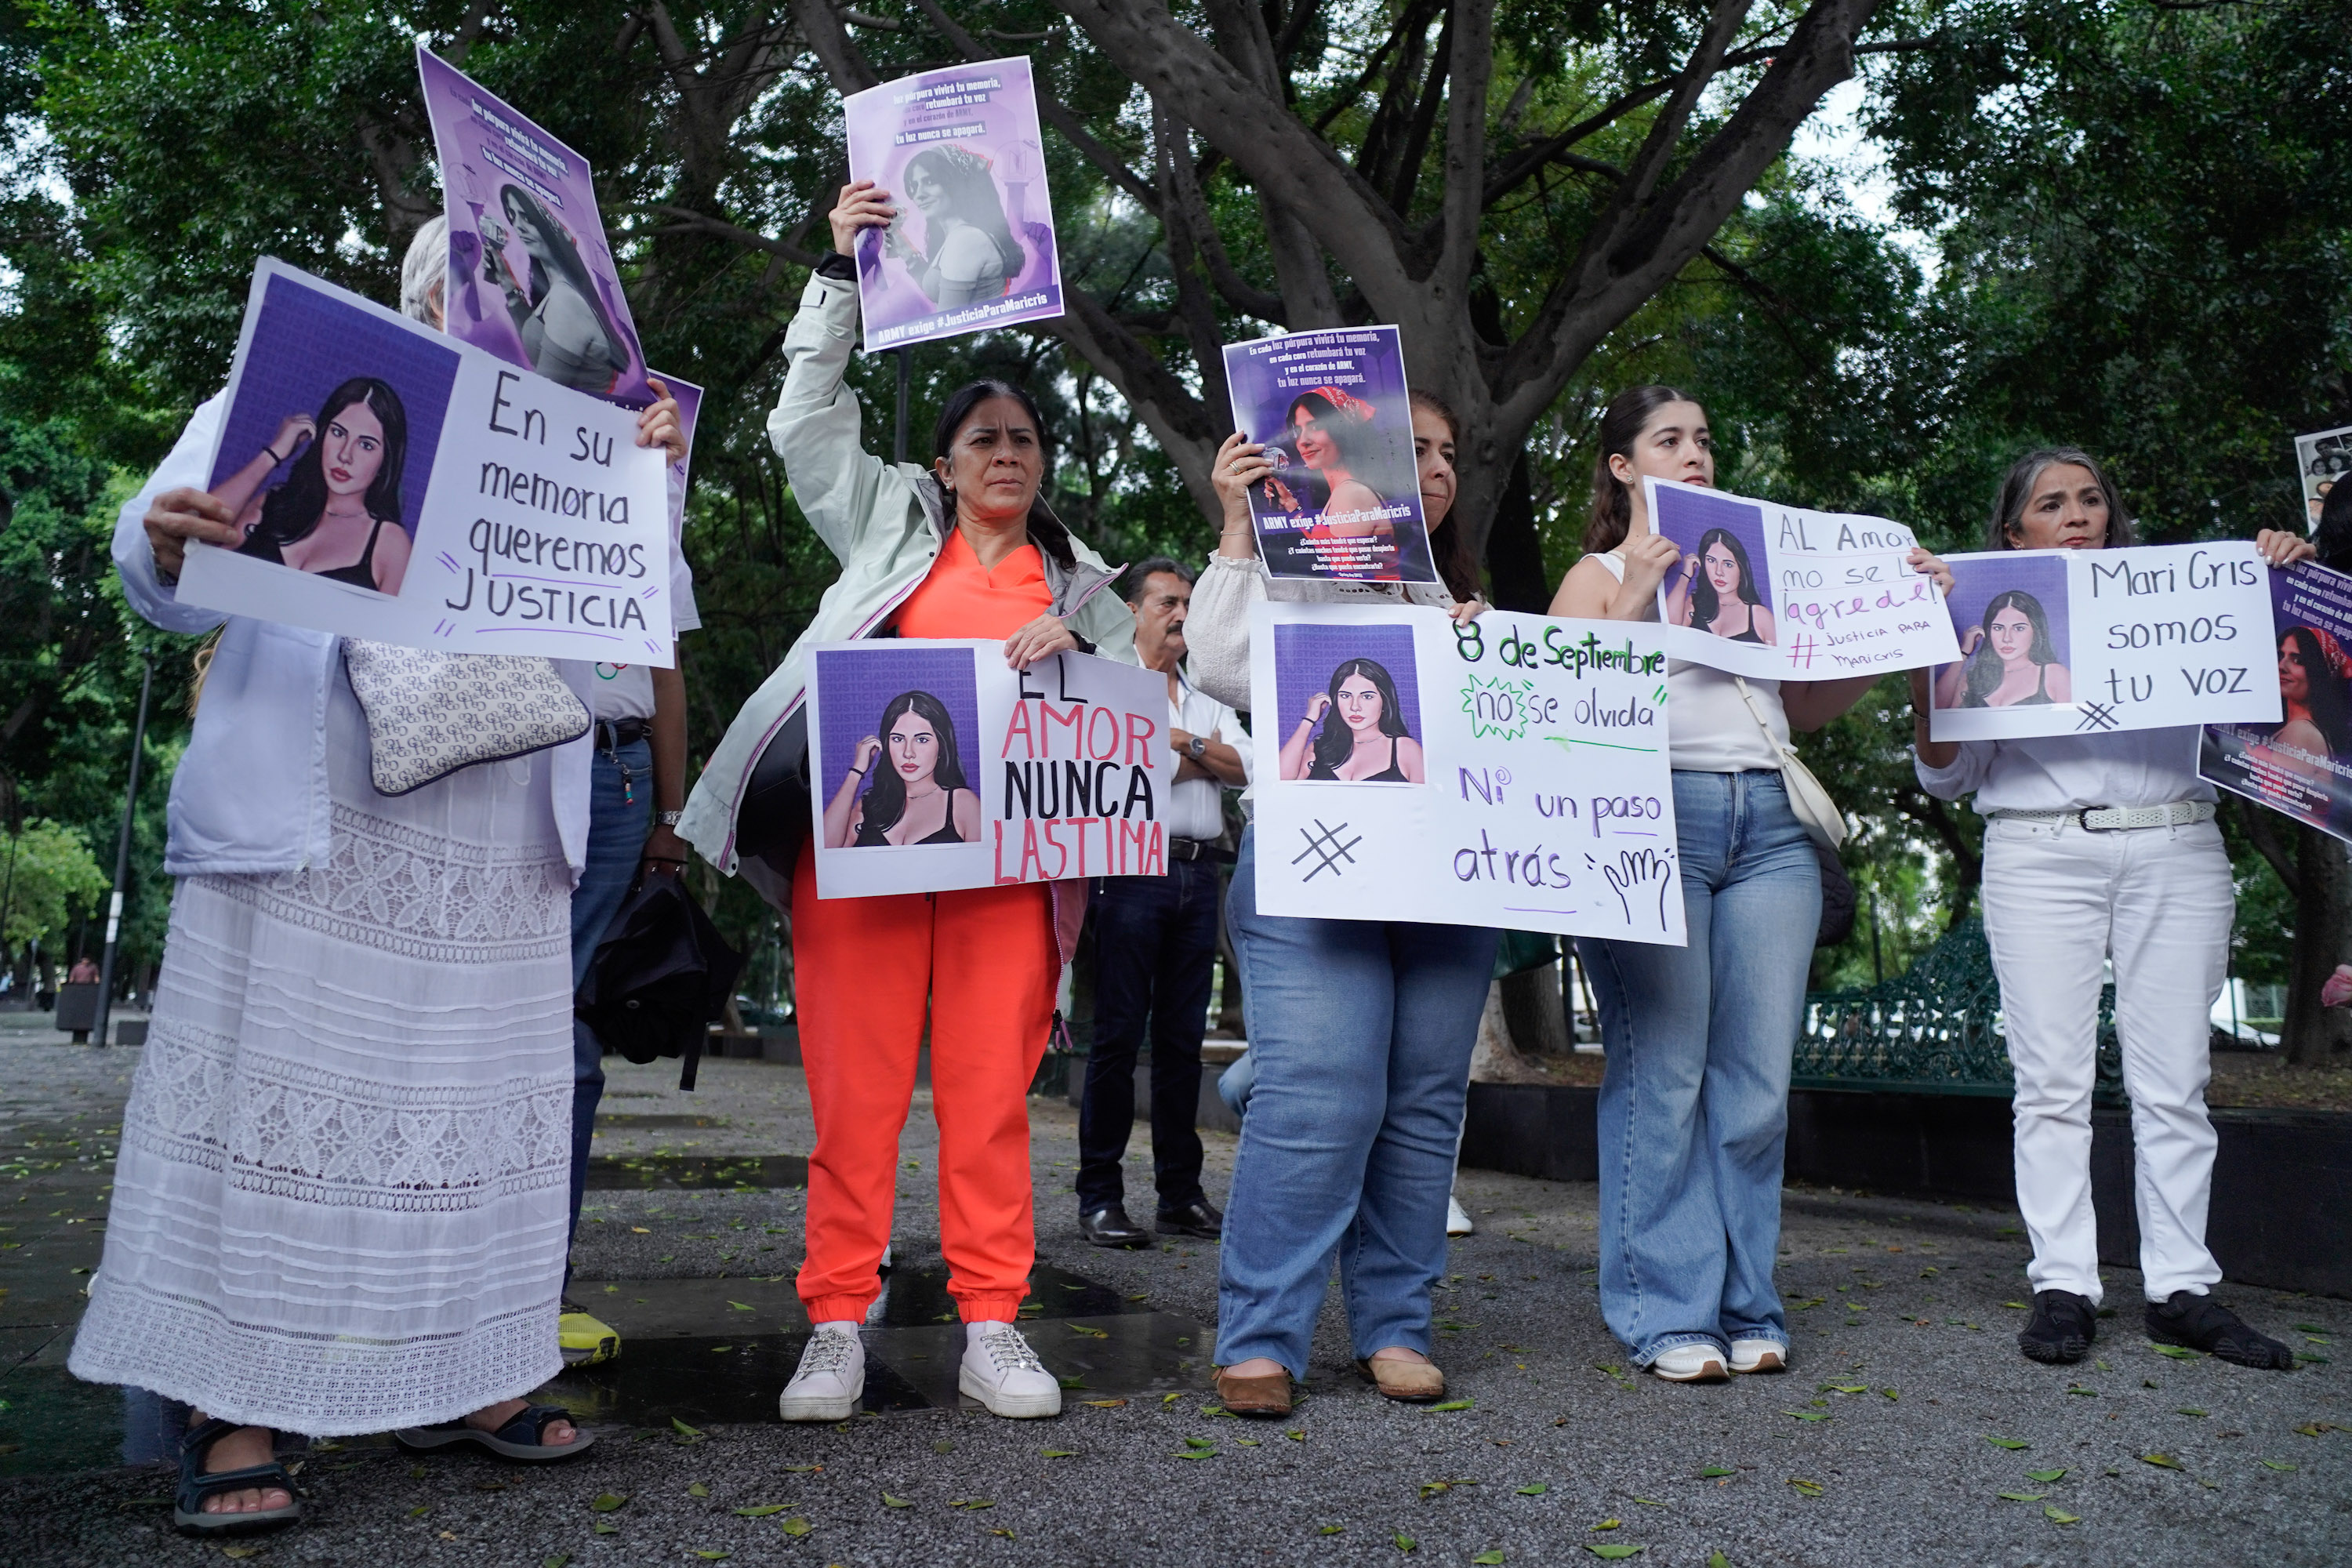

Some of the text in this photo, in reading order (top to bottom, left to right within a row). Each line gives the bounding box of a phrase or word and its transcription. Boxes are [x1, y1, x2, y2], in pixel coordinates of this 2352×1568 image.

[905, 88, 933, 104] púrpura
[934, 82, 955, 96] vivirá
[956, 81, 965, 93] tu
[966, 77, 1001, 92] memoria,
[925, 95, 963, 110] retumbará
[964, 93, 973, 105] tu
[973, 93, 986, 103] voz
[946, 109, 954, 118] de
[895, 122, 986, 145] tu luz nunca se apagará.
[878, 292, 1048, 344] ARMY exige #JusticiaParaMaricris
[1249, 330, 1380, 356] En cada luz púrpura vivirá tu memoria,
[1277, 352, 1293, 362] cada
[1306, 347, 1344, 359] retumbará
[1344, 346, 1353, 357] tu
[1354, 347, 1367, 356] voz
[1277, 377, 1287, 388] tu
[1287, 376, 1299, 387] luz
[1299, 376, 1323, 386] nunca
[1334, 372, 1367, 386] apagará.
[1284, 366, 1289, 376] y
[1298, 363, 1305, 372] el
[1305, 362, 1328, 372] corazón
[1328, 361, 1336, 370] de
[1336, 360, 1355, 370] ARMY,
[488, 370, 614, 467] En su
[479, 462, 630, 524] memoria
[1262, 503, 1412, 530] ARMY exige #JusticiaParaMaricris
[1780, 514, 1817, 551] AL
[1838, 523, 1913, 551] Amor
[469, 517, 647, 579] queremos
[1844, 566, 1885, 584] se
[2091, 560, 2175, 598] Mari
[2306, 568, 2336, 586] púrpura
[445, 568, 648, 631] JUSTICIA
[2282, 600, 2292, 612] tu
[2291, 603, 2303, 617] luz
[2302, 611, 2324, 626] nunca
[2323, 620, 2334, 631] se
[1897, 620, 1932, 634] PARA
[2107, 614, 2238, 649] somos
[1454, 619, 1665, 679] 8 de Septiembre
[1019, 654, 1089, 704] EL
[2103, 666, 2253, 705] tu voz
[1475, 690, 1513, 722] no
[1574, 687, 1654, 728] olvida
[1001, 699, 1157, 770] AMOR
[2238, 728, 2259, 746] exige
[1004, 760, 1155, 821] NUNCA
[1458, 765, 1662, 839] Ni un paso
[993, 817, 1167, 886] LASTIMA
[1454, 827, 1571, 890] atrás
